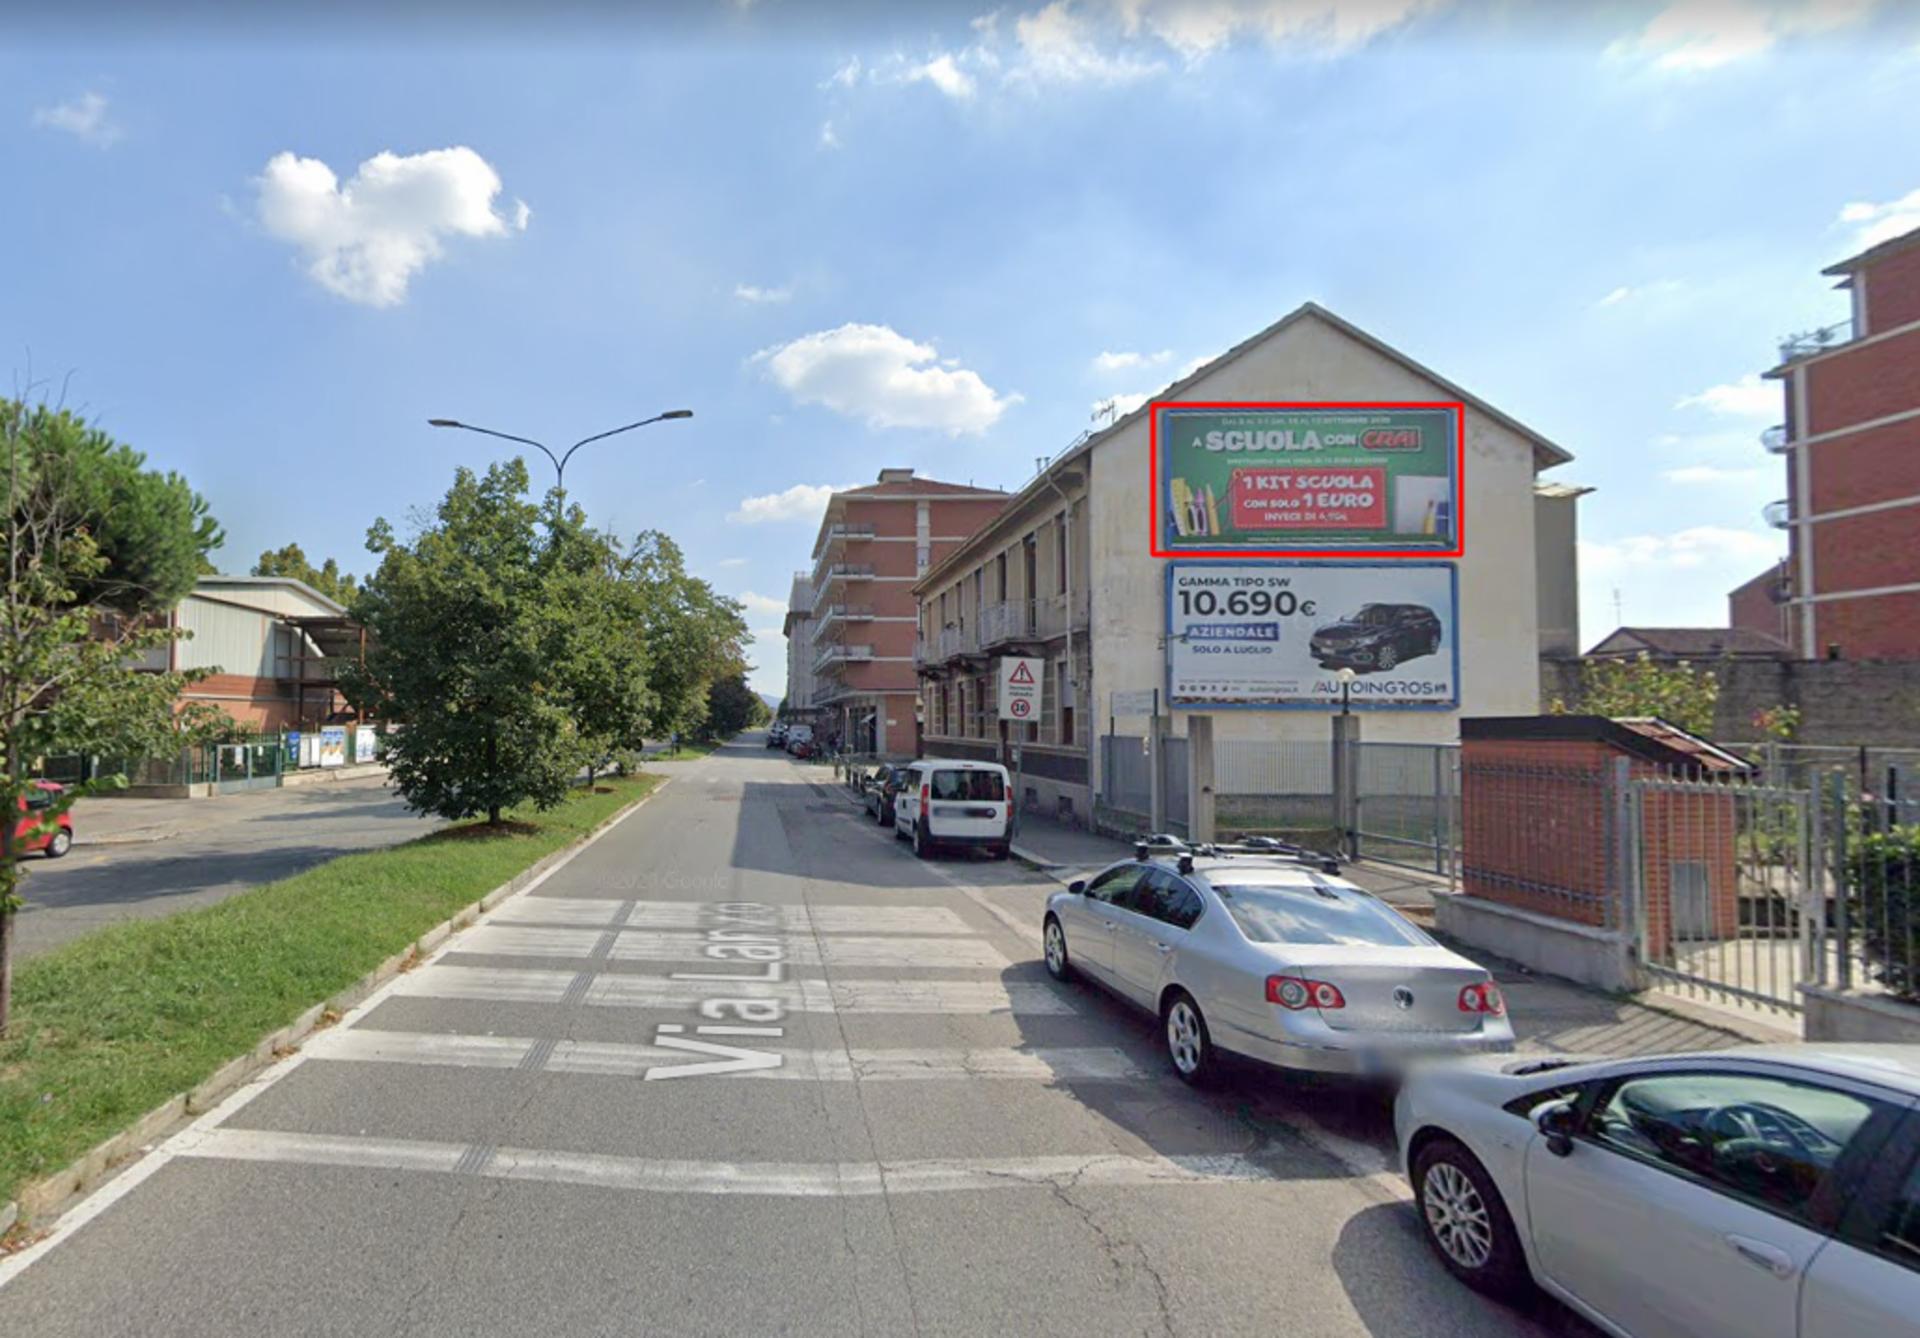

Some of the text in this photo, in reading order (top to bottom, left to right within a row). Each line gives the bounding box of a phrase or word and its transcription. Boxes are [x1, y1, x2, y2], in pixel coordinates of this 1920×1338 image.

[1192, 437, 1202, 448] A
[1205, 430, 1323, 450] SCUOLA
[1324, 434, 1356, 446] CON
[1243, 475, 1374, 490] 1 KIT SCUOLA
[1243, 493, 1374, 509] CON SOLO 1 EURO
[1264, 512, 1301, 522] INVECE
[1178, 576, 1291, 588] GAMMA TIPO SW
[1189, 626, 1275, 639] AZIENDALE
[1192, 645, 1273, 655] SOLO A LUGLIO
[1312, 680, 1433, 695] AUOINGROS
